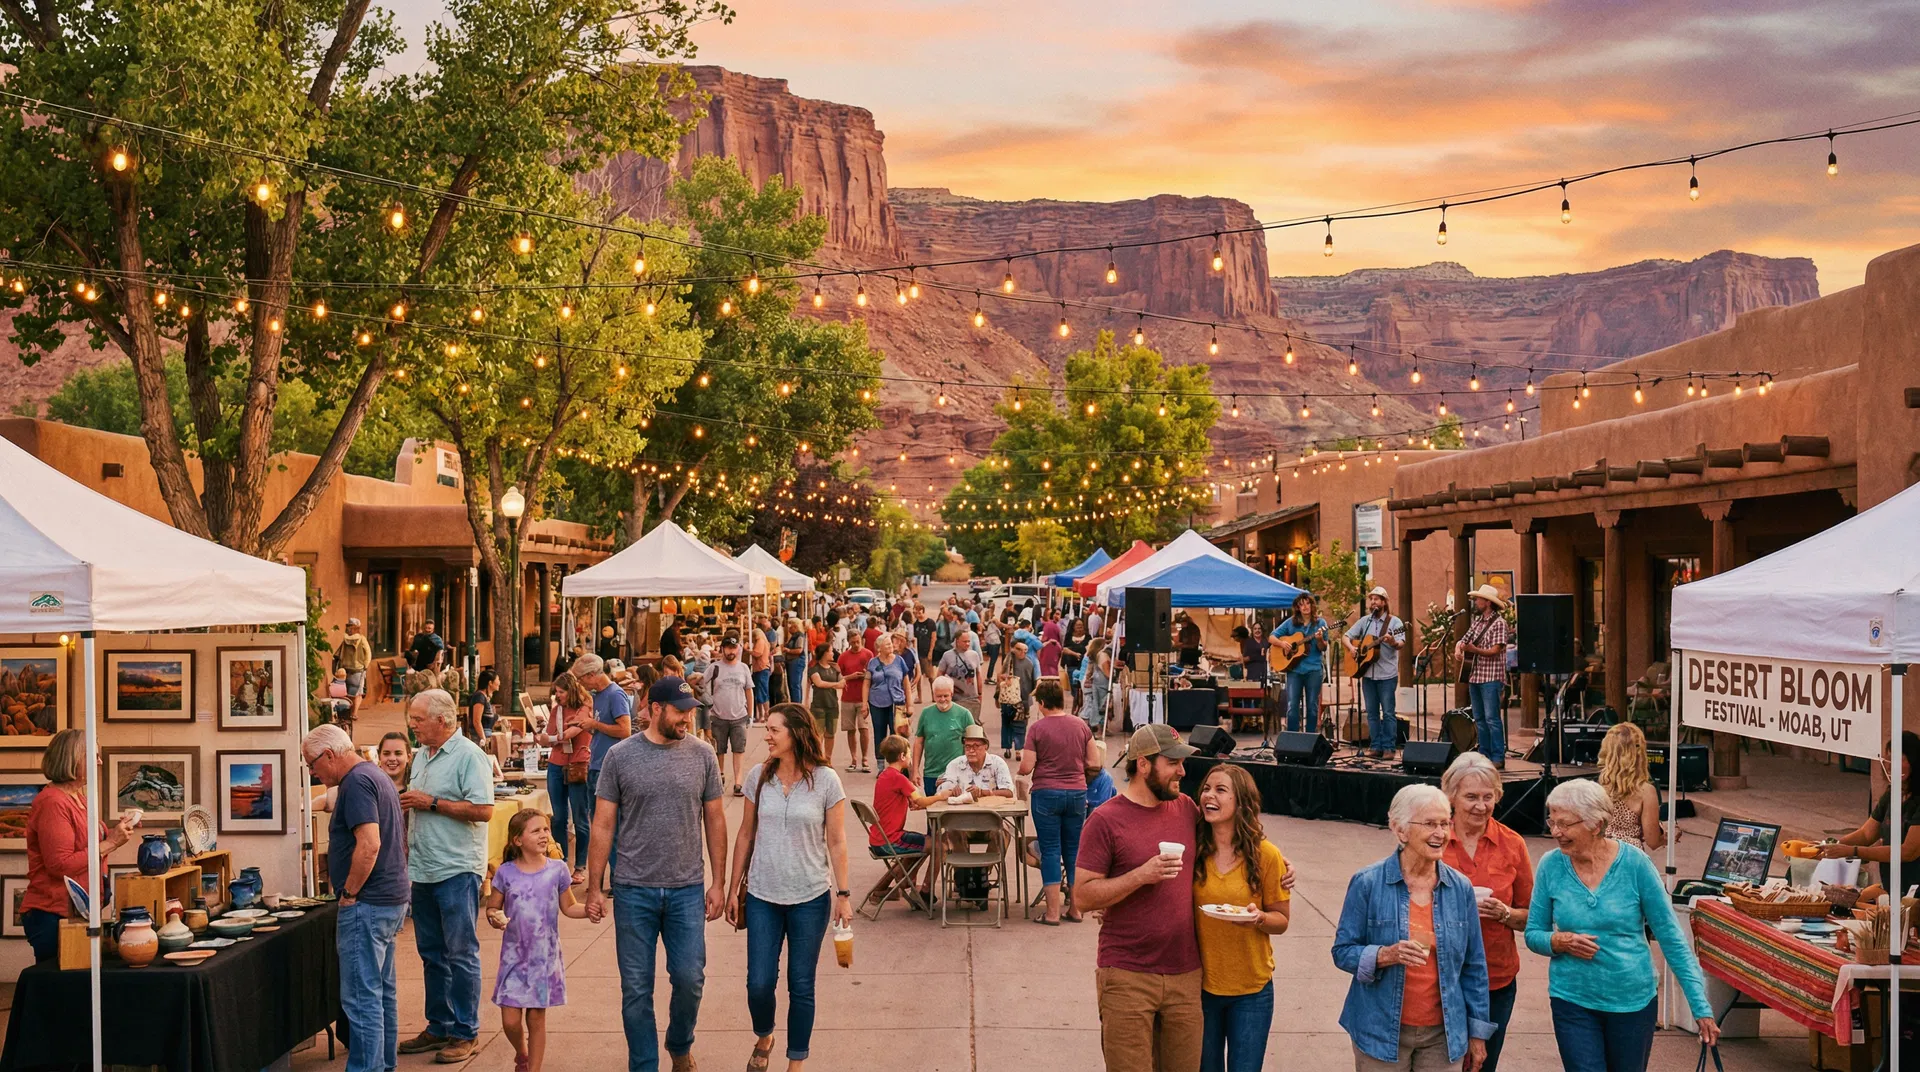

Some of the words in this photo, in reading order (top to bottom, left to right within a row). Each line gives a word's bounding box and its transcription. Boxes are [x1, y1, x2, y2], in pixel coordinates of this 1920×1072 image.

[1688, 657, 1773, 701] DESERT
[1780, 666, 1873, 714] BLOOM
[1704, 699, 1766, 729] FESTIVAL
[1778, 709, 1826, 744] MOAB,
[1830, 717, 1852, 743] UT
